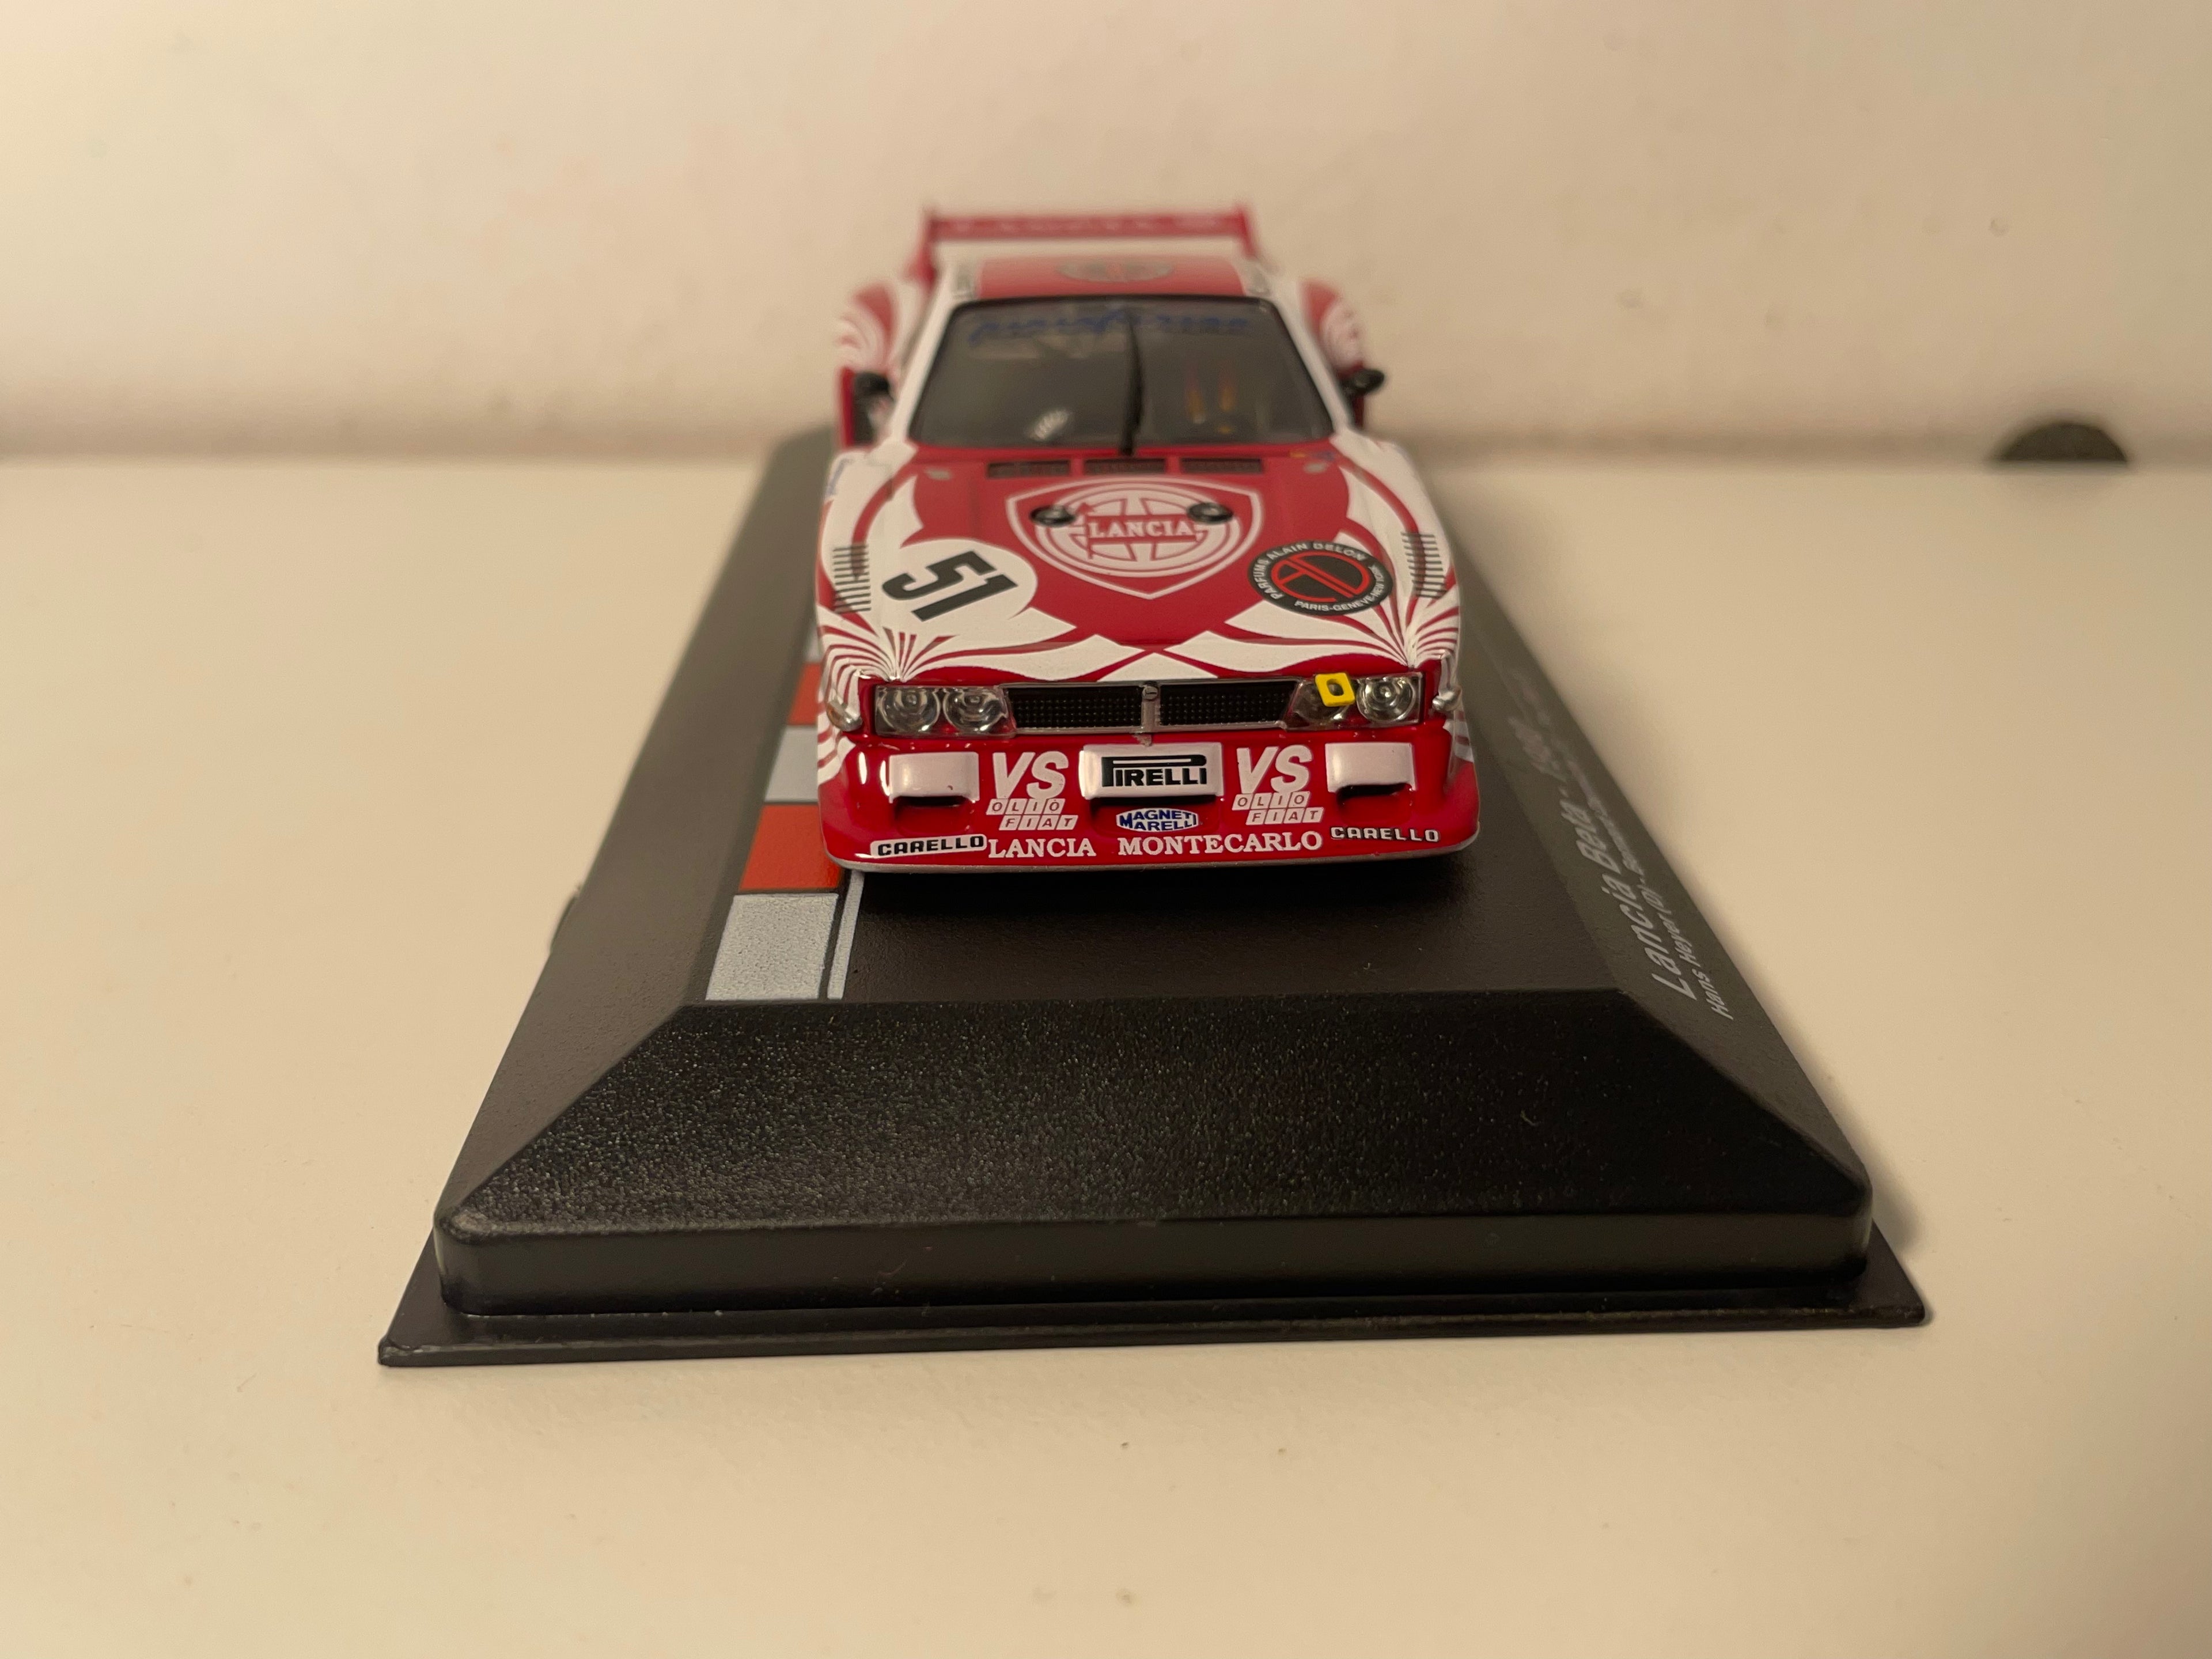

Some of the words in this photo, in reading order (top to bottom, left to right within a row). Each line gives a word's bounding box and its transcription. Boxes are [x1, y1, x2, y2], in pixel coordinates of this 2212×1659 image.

[1088, 520, 1193, 537] LANCIA
[1266, 543, 1308, 560] ALAIN
[1313, 543, 1365, 561] DELON
[882, 551, 1018, 622] 51
[1253, 558, 1284, 599] PARFUMS
[993, 751, 1069, 798] VS
[1101, 754, 1207, 787] PIRELLI
[1237, 744, 1313, 793] VS
[991, 801, 1061, 813] OLIO
[1237, 794, 1305, 808] OLIO
[1004, 817, 1074, 828] FIAT
[1119, 809, 1197, 825] MAGNETI
[1119, 816, 1197, 831] MARELLI
[1251, 809, 1319, 824] FIAT
[988, 838, 1097, 858] LANCIA
[1117, 831, 1323, 856] MONTECARLO
[1330, 826, 1440, 843] CARELLO
[1559, 798, 1621, 874] Beta
[877, 835, 984, 857] CARELLO
[1601, 873, 1697, 1000] Lancia
[1658, 912, 1702, 967] Heyer
[1692, 968, 1734, 1021] Hans
